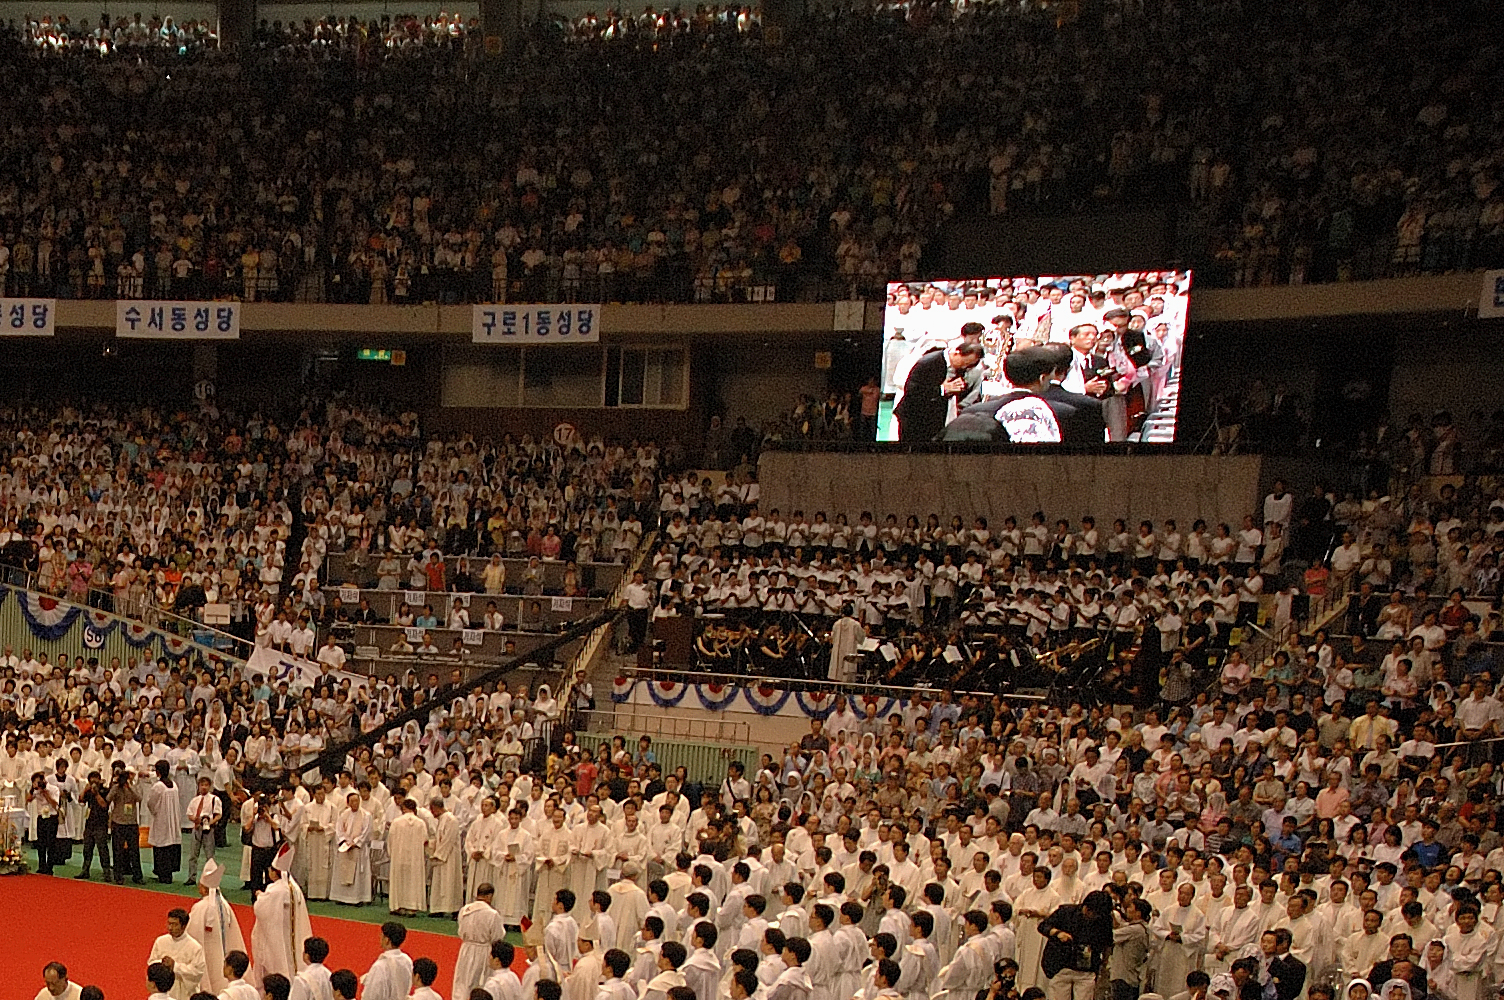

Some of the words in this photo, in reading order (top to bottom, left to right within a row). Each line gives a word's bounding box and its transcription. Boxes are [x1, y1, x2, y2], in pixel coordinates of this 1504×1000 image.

[125, 306, 233, 332] 수서동성당
[482, 309, 593, 336] 구로1동성당
[556, 427, 573, 441] 17
